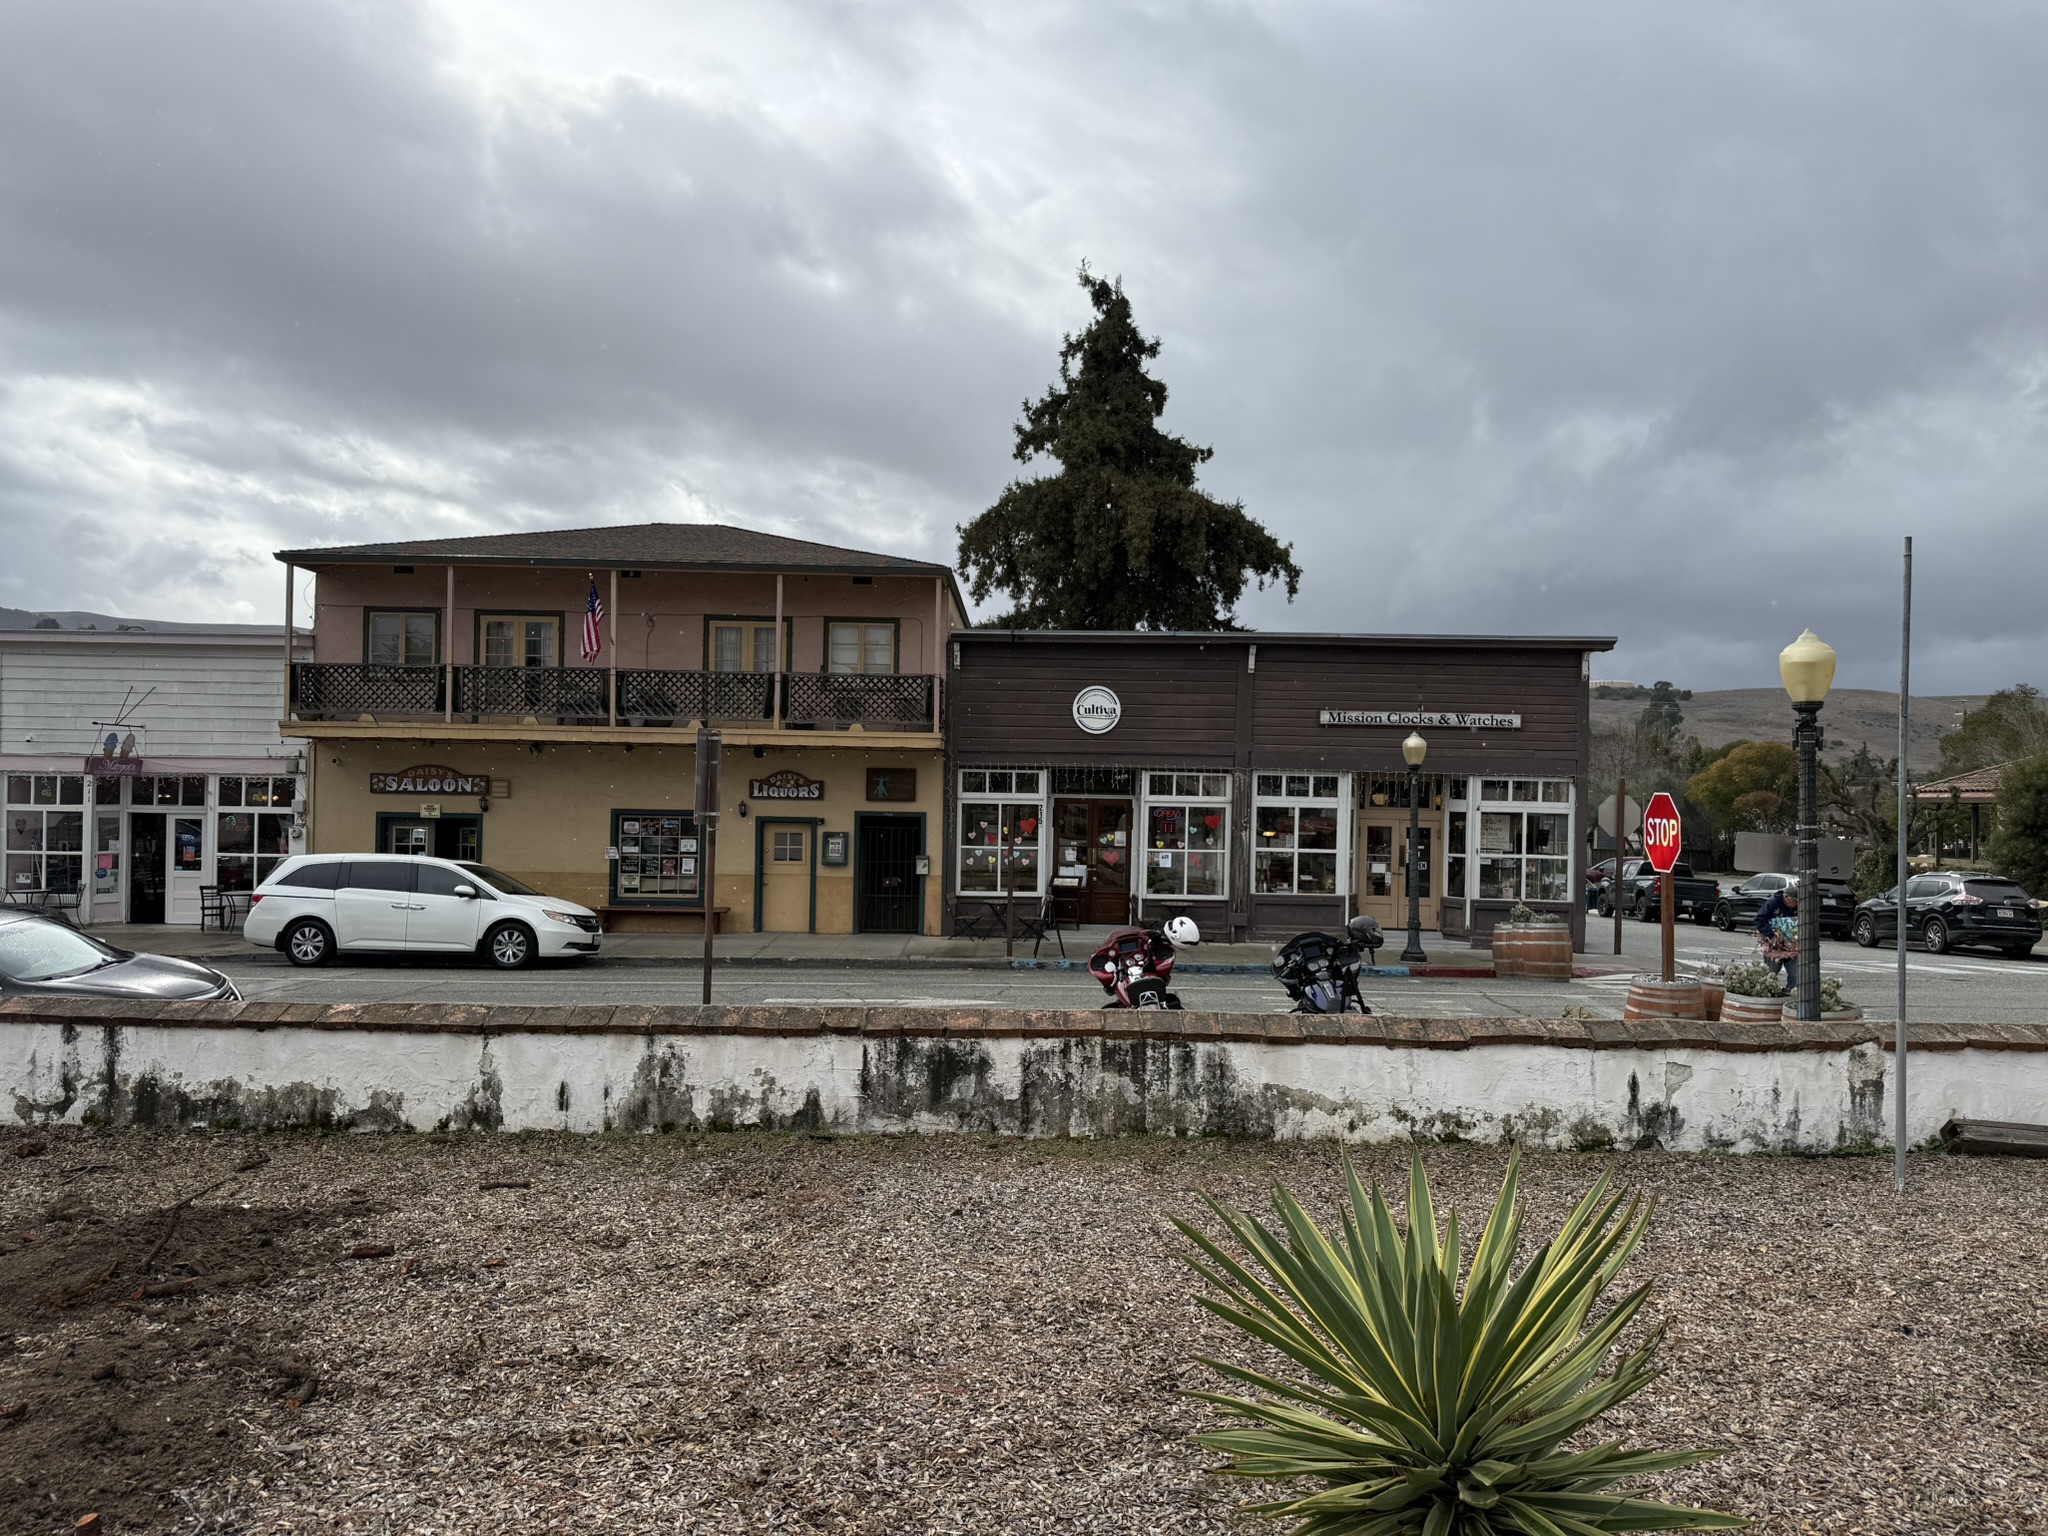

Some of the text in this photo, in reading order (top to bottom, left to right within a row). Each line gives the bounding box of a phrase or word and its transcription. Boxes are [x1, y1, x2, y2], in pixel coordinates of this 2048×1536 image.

[1077, 704, 1117, 716] Cultiva
[1328, 711, 1514, 727] Mission Clocks & Watches
[408, 767, 454, 779] DAISY'S
[769, 773, 805, 785] DAISY'S
[385, 776, 473, 792] SALOON
[752, 780, 820, 798] LIQUORS
[1156, 810, 1179, 818] OPEN
[1647, 817, 1678, 848] STOP
